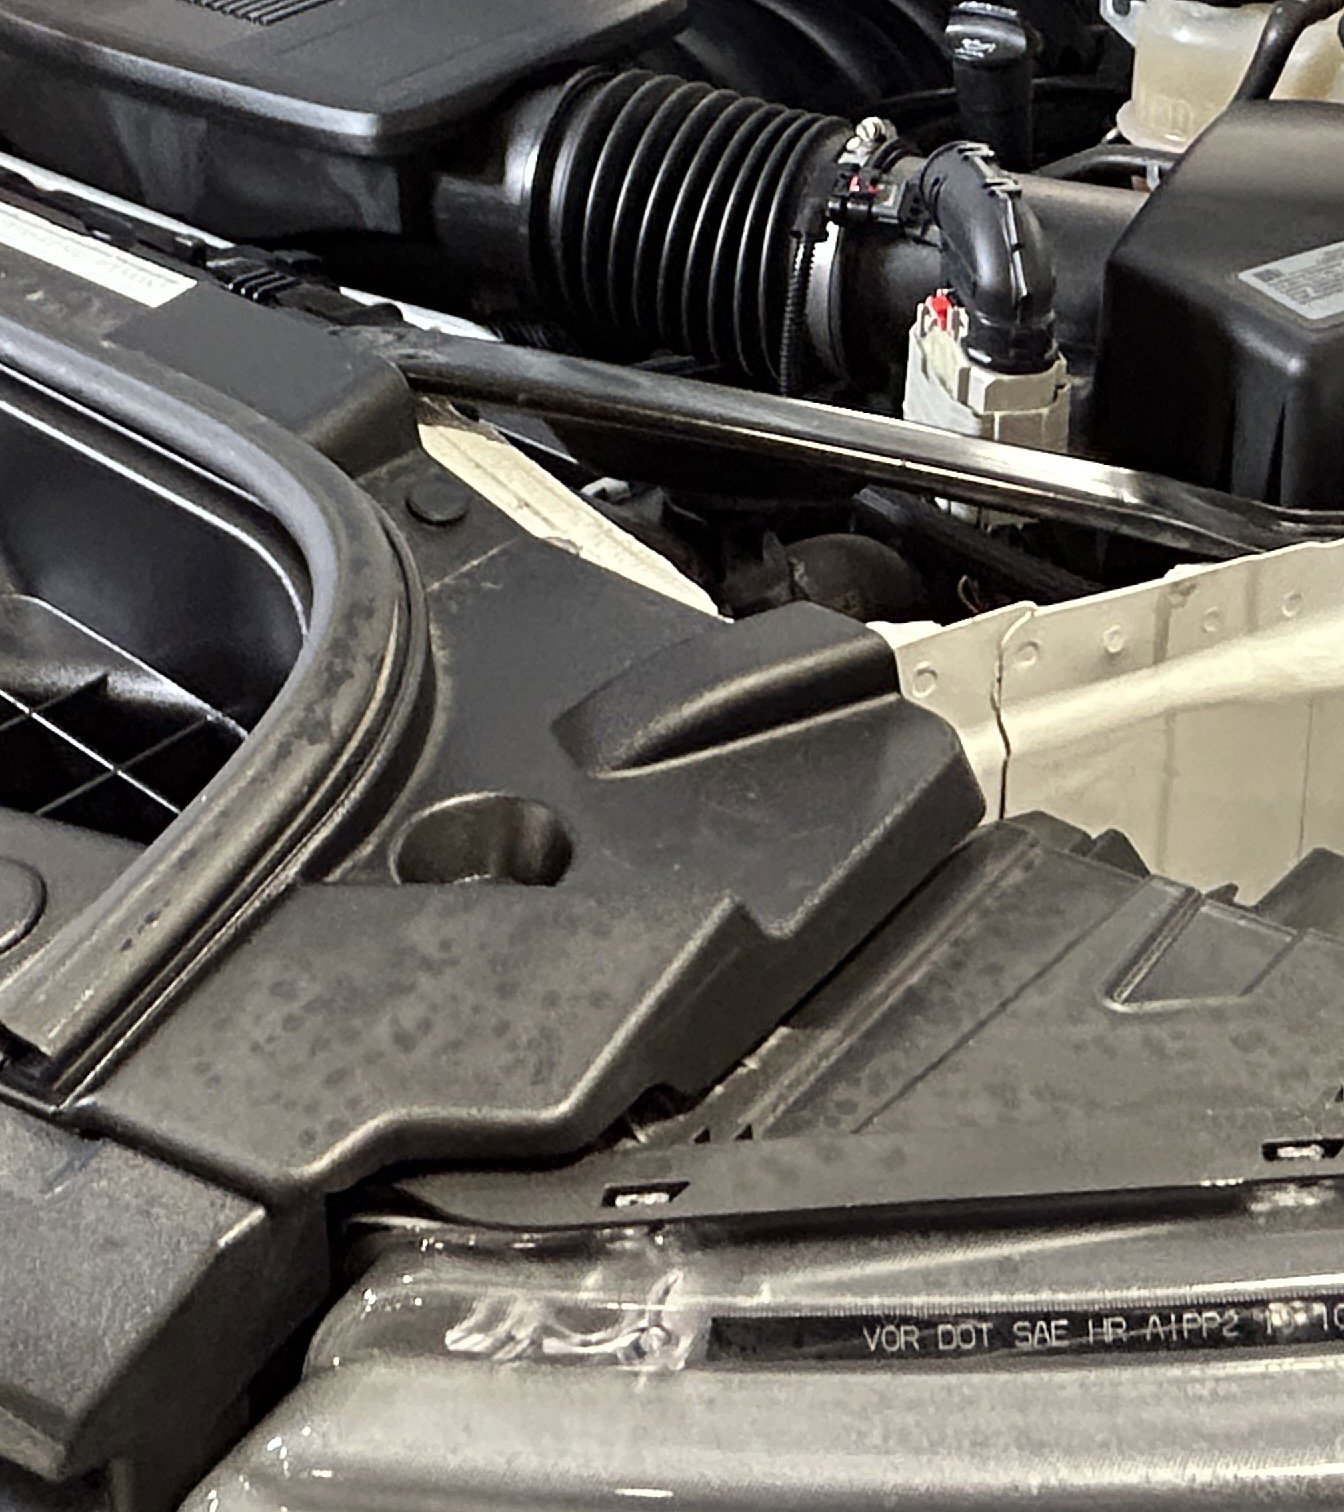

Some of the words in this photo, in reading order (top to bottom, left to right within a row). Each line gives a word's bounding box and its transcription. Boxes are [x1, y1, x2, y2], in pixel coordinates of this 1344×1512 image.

[862, 1324, 919, 1352] VOR
[937, 1321, 993, 1350] DOT
[1013, 1318, 1069, 1349] SAE
[1088, 1316, 1127, 1344] HR
